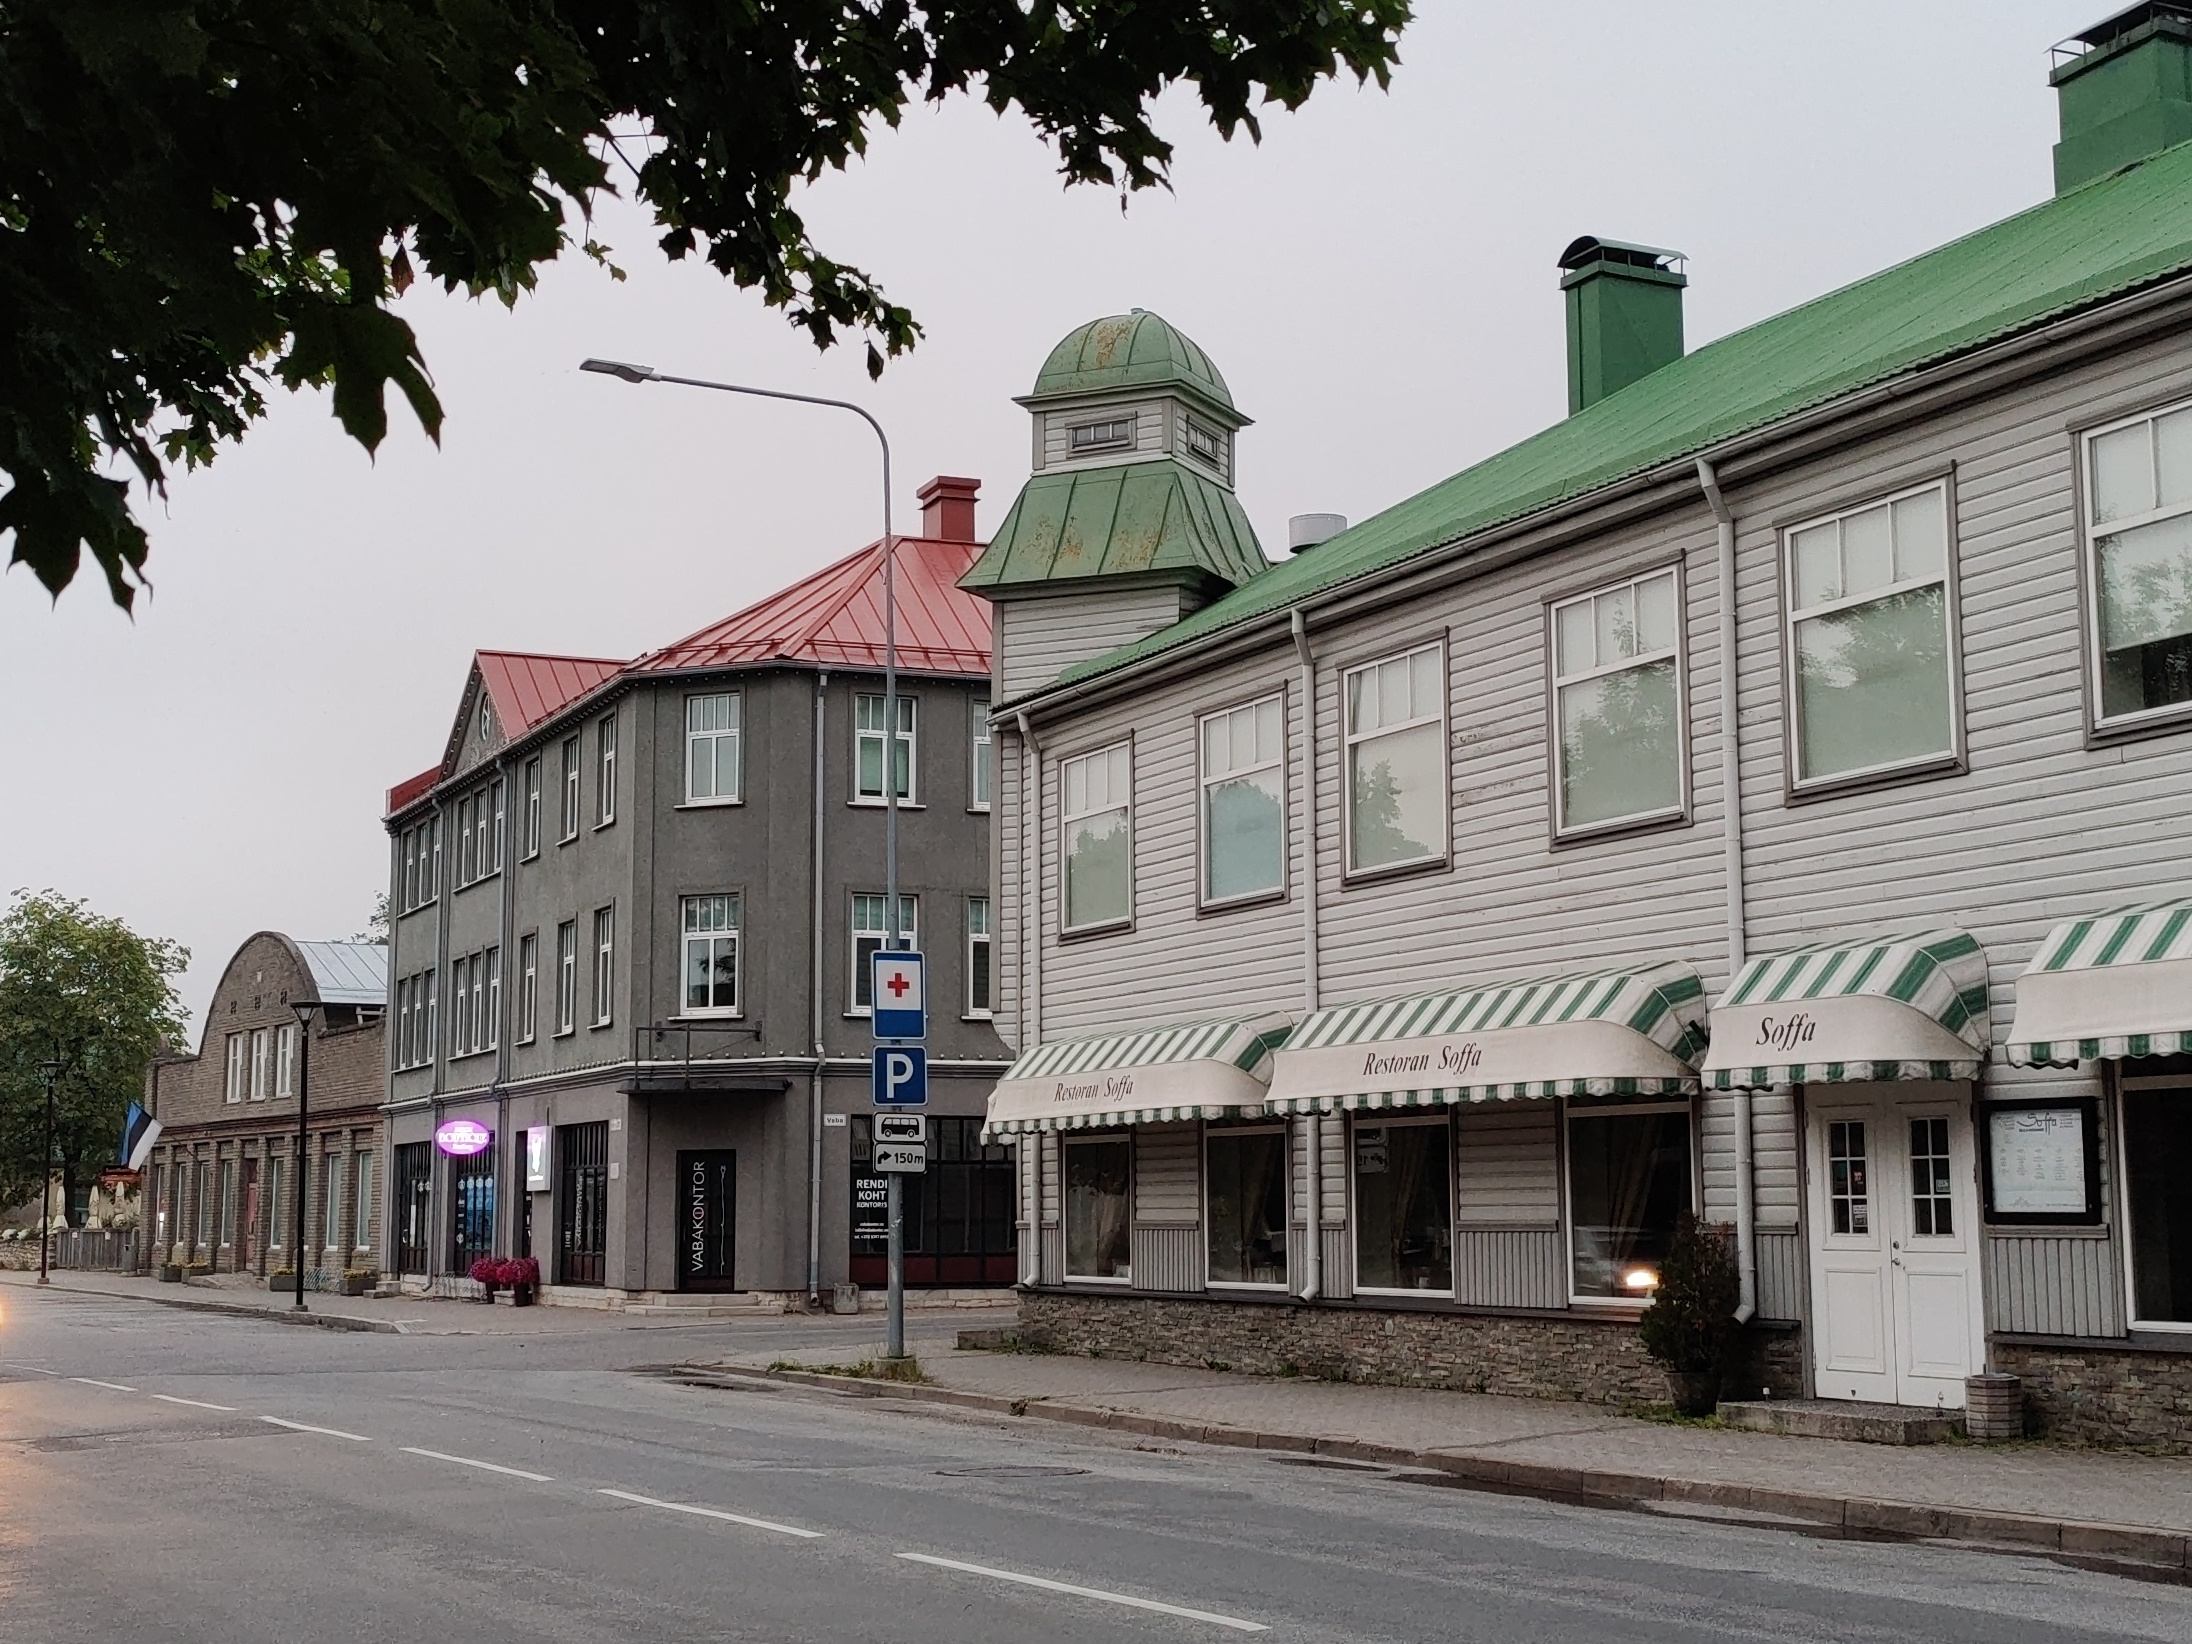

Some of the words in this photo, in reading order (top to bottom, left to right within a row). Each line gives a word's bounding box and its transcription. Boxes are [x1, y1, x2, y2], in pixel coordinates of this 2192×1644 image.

[1755, 1012, 1816, 1052] Soffa
[886, 1053, 914, 1099] P
[1362, 1052, 1430, 1076] Restoran
[1437, 1042, 1482, 1076] Soffa
[1054, 1082, 1099, 1102] Restoran
[1103, 1074, 1134, 1102] Soffa
[856, 1179, 888, 1189] RENDI
[858, 1190, 887, 1201] KOHT
[691, 1161, 706, 1272] VABAKONTOR
